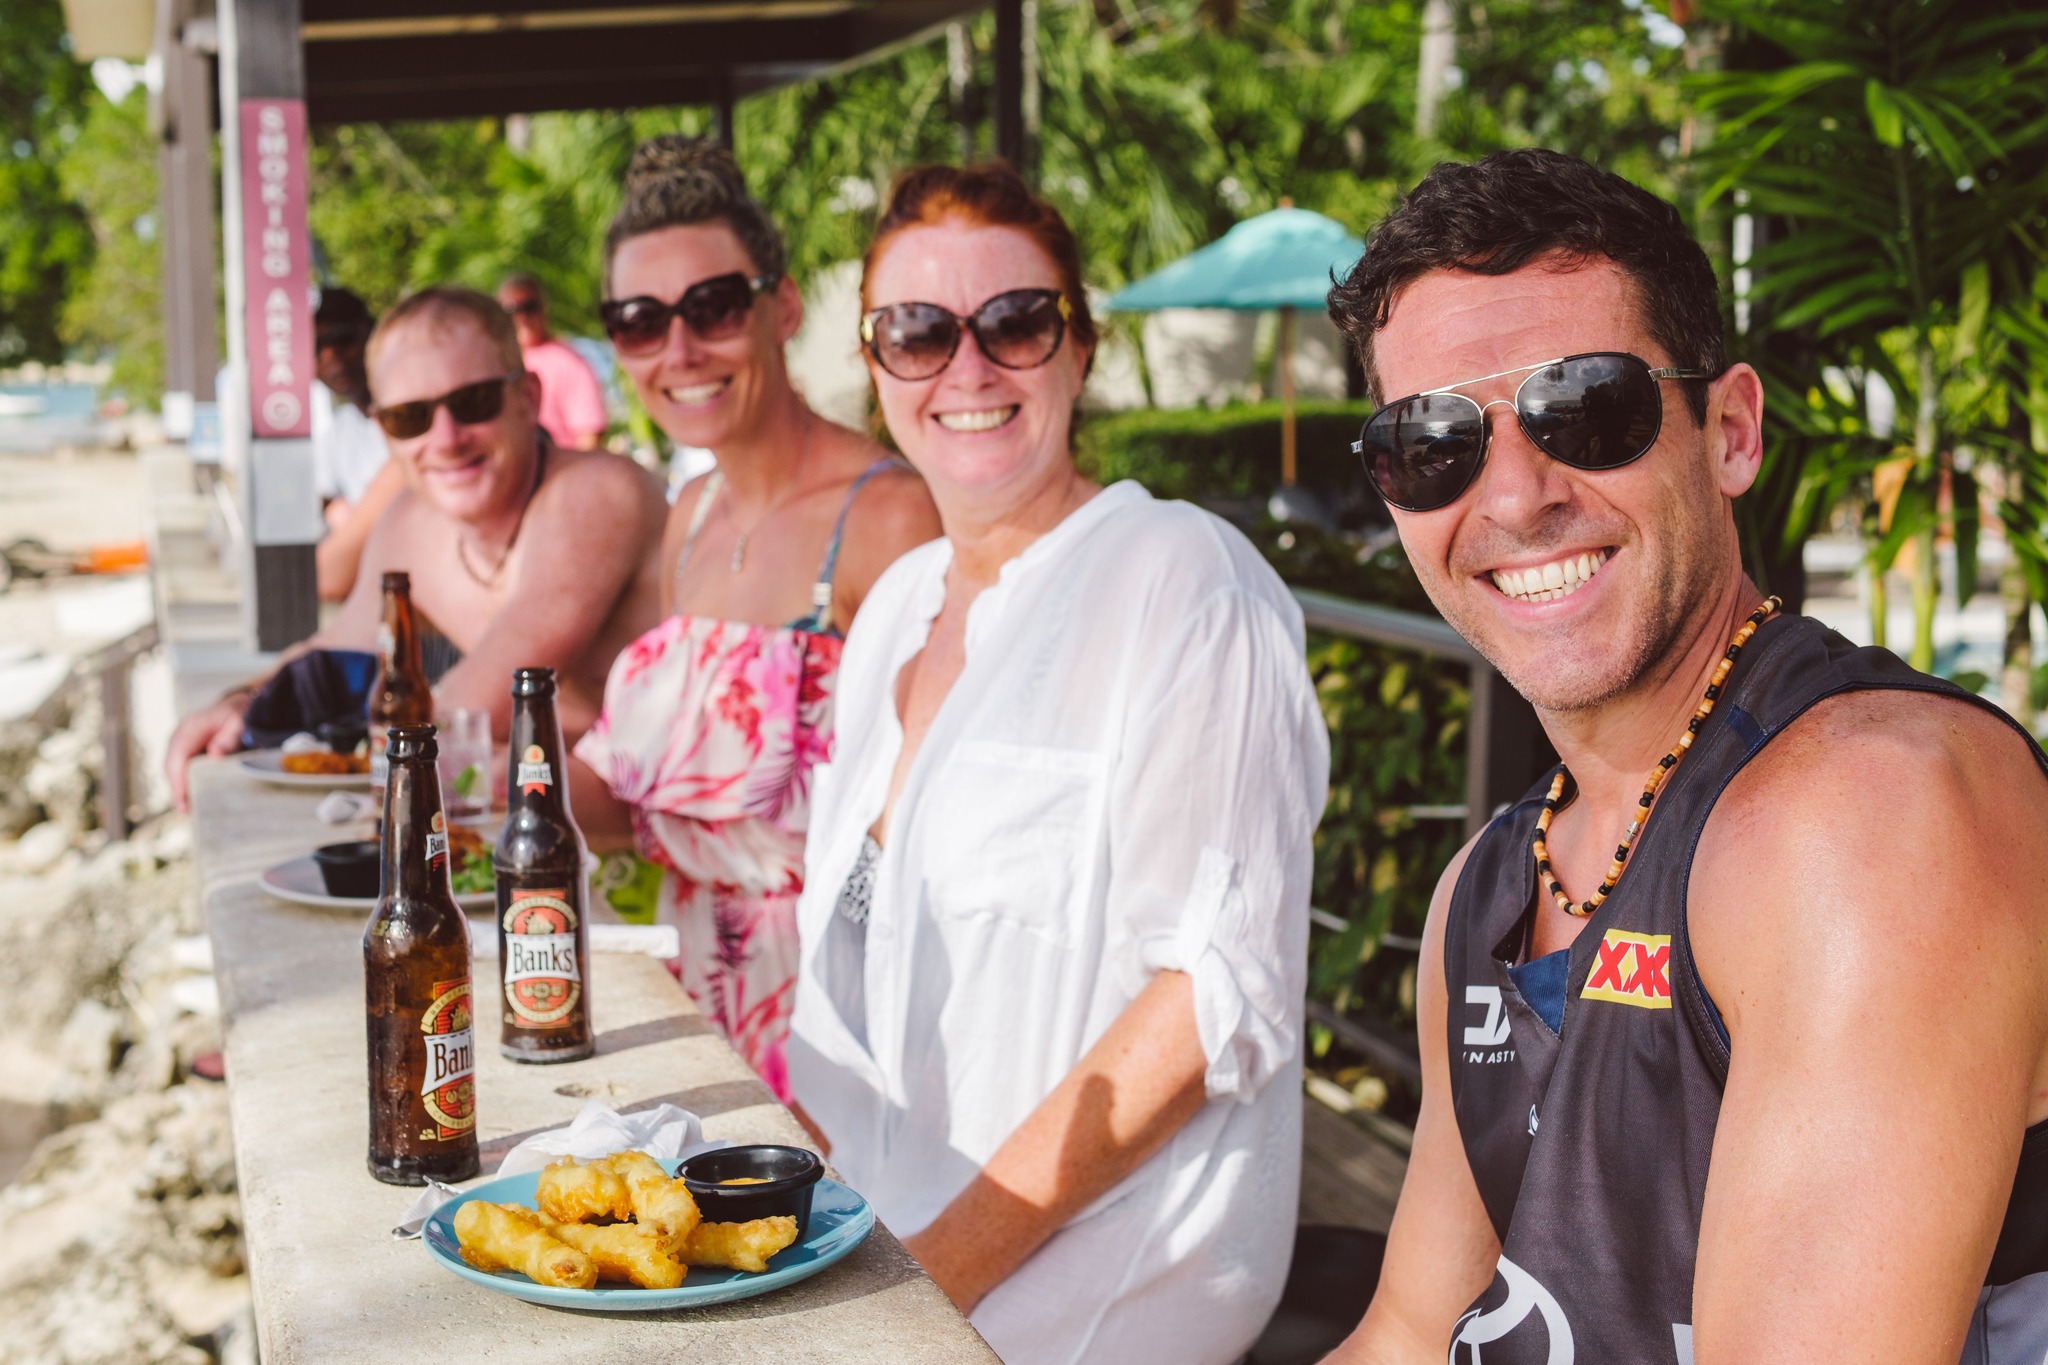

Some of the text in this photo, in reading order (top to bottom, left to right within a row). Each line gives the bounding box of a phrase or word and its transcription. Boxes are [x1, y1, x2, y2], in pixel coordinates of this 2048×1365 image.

[258, 106, 294, 386] SMOKING AREA
[513, 942, 574, 974] Banks
[1462, 1050, 1515, 1064] NASTY
